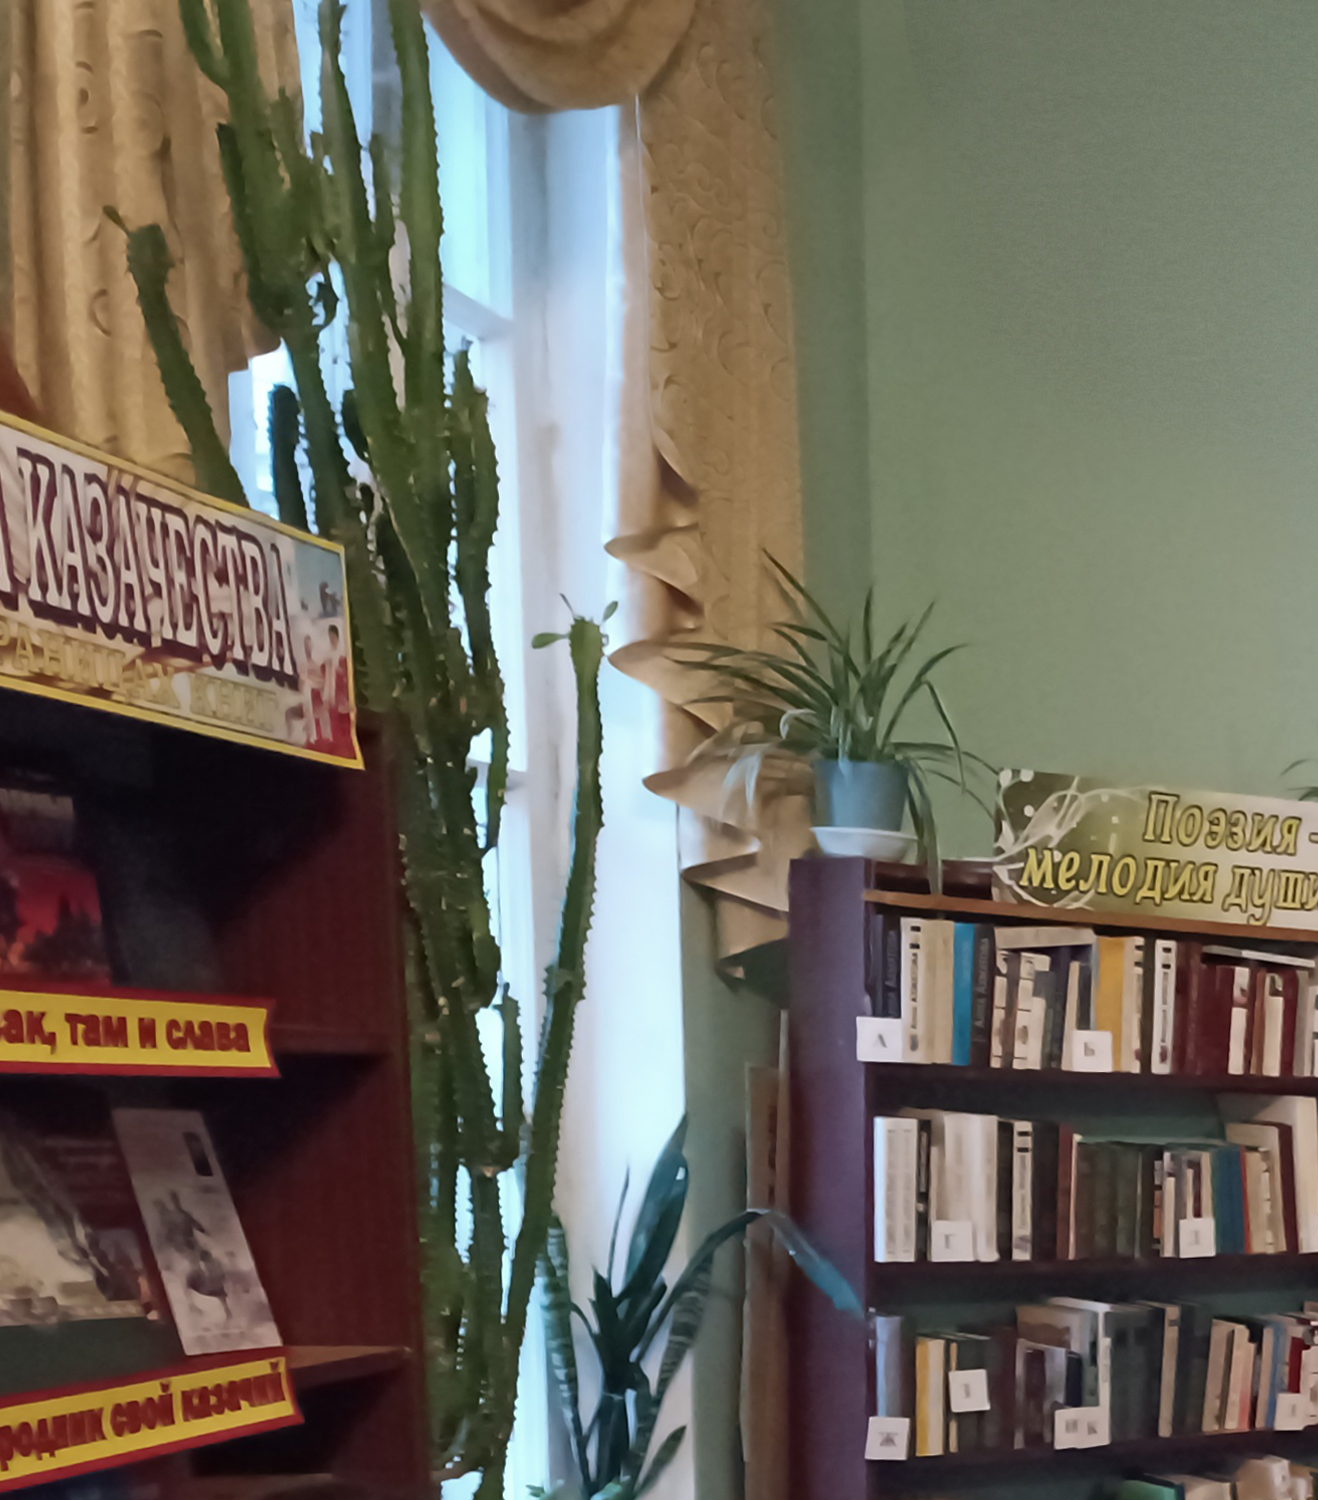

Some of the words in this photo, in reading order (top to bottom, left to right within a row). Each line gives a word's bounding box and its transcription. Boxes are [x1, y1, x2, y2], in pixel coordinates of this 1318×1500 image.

[15, 446, 299, 684] КАЗАЧЕСТВА
[1142, 791, 1303, 857] Поэзия
[1019, 847, 1219, 907] мелодия
[0, 1010, 57, 1055] ак,
[65, 1012, 129, 1049] там
[138, 1016, 156, 1048] и
[166, 1020, 251, 1053] слава
[110, 1381, 175, 1437] свой
[180, 1360, 287, 1423] казачий
